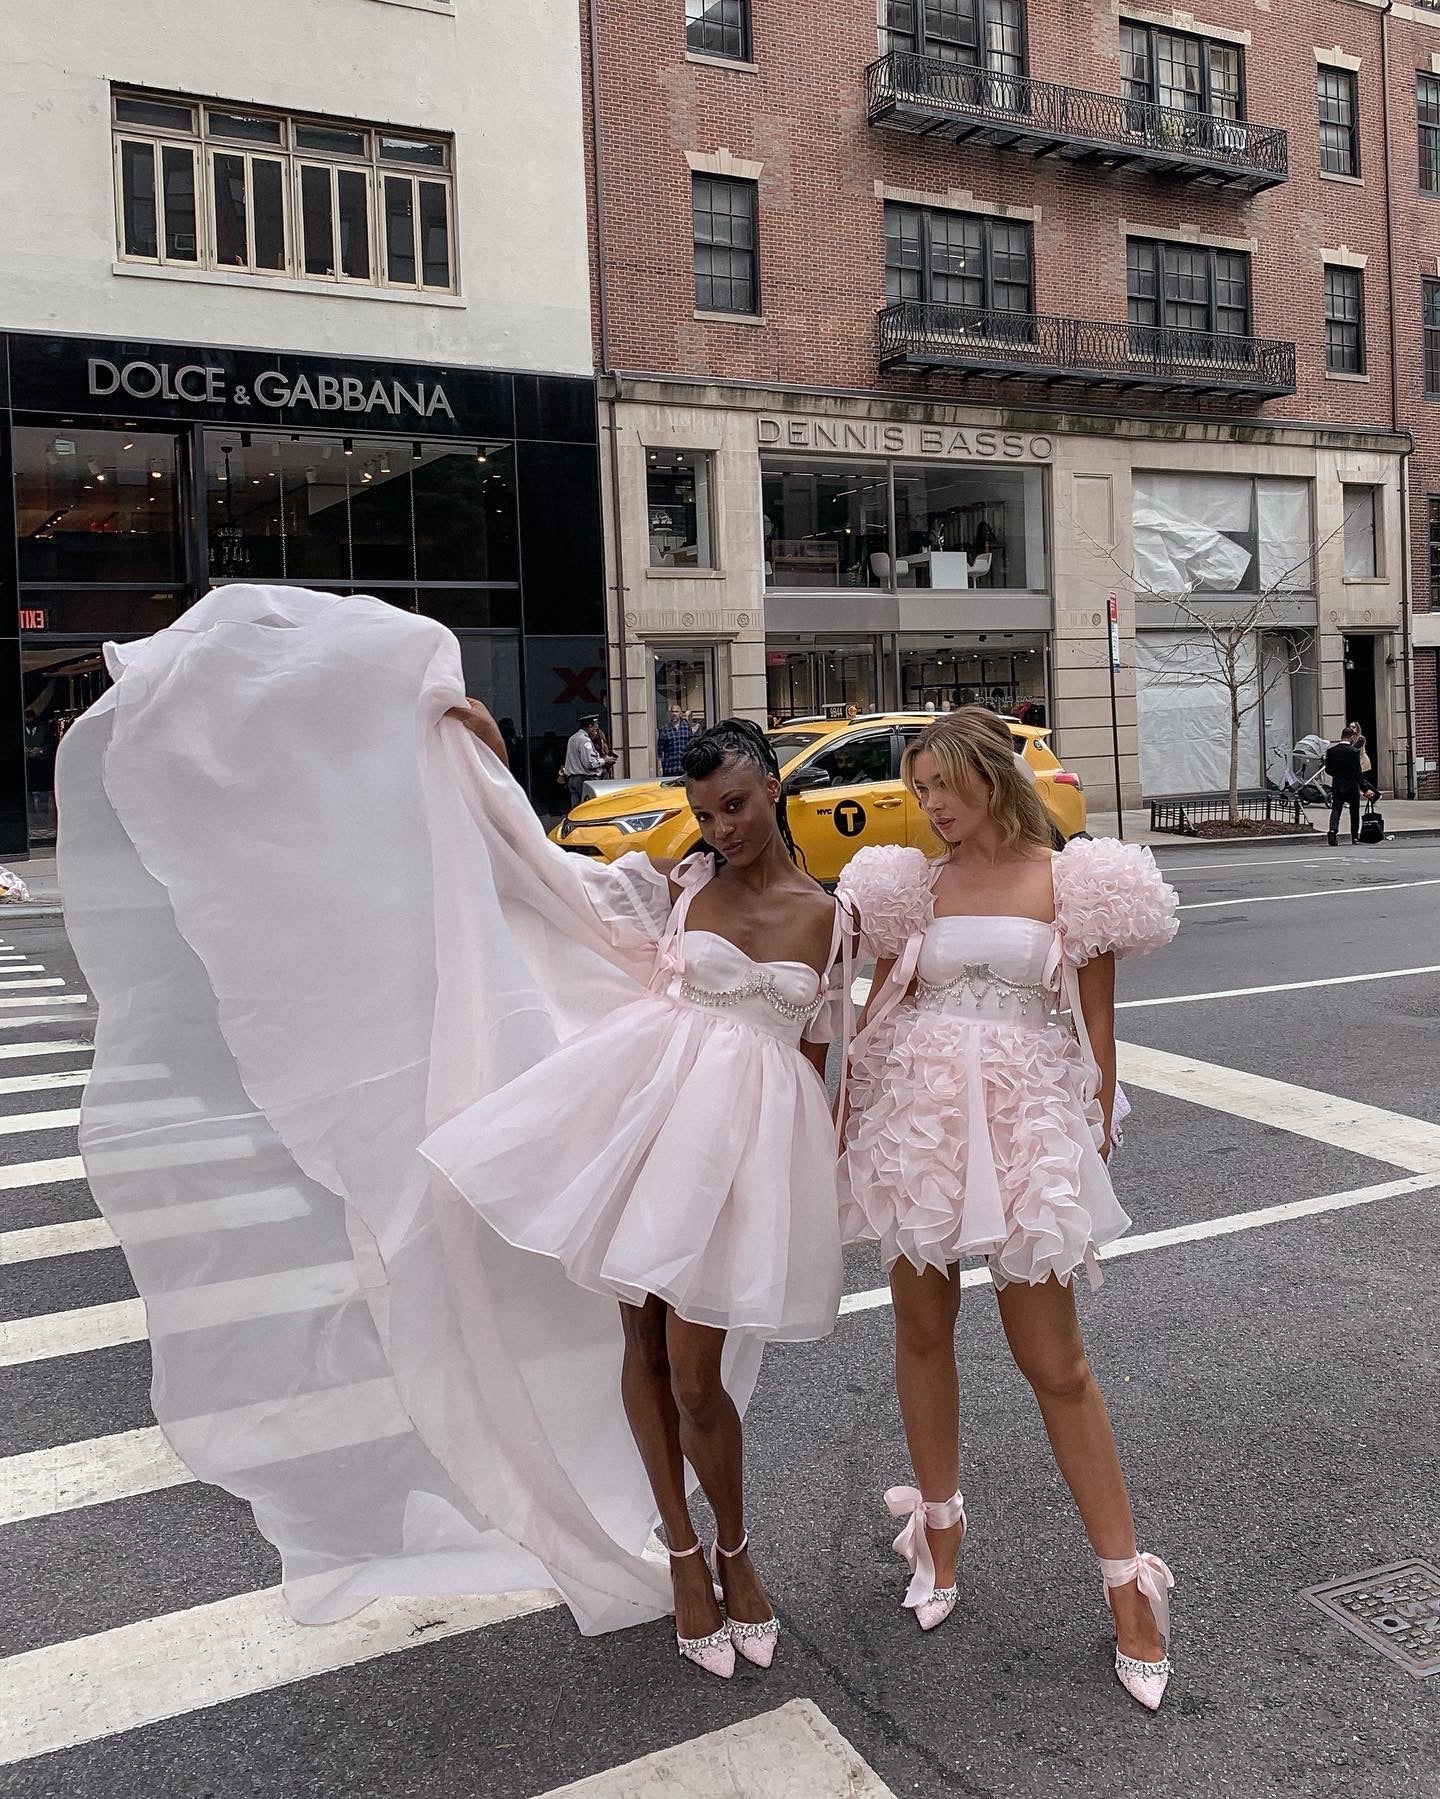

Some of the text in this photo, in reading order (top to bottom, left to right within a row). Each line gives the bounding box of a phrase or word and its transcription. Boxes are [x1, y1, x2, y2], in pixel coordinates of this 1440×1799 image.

[87, 358, 455, 419] DOLCE & GABBANA
[756, 416, 1053, 459] DENNIS BASSO
[979, 695, 1014, 705] DENNIS
[816, 807, 858, 832] NYC T
